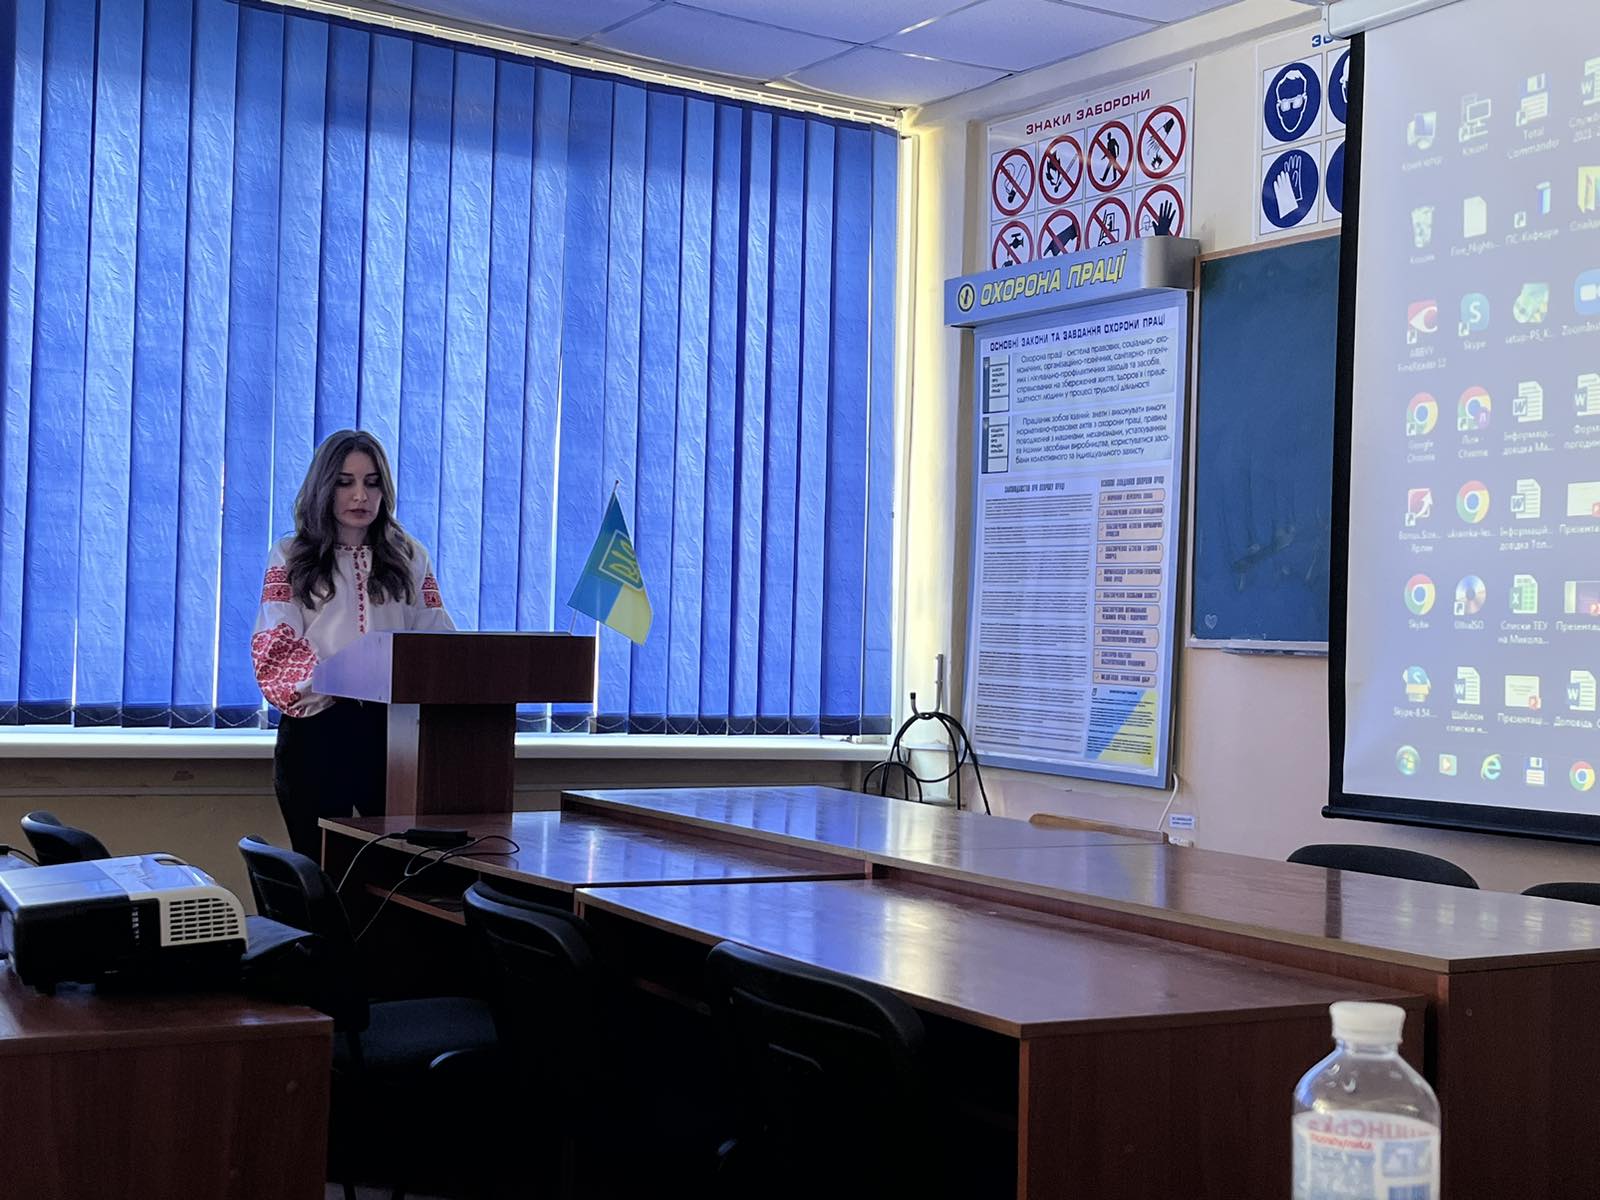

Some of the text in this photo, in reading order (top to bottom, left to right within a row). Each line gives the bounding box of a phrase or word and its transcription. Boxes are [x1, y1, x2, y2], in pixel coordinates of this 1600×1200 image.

[1026, 88, 1151, 135] ЗНАКИ ЗАБОРОНИ
[980, 248, 1128, 307] ОХОРОНА ПРАЦІ
[990, 313, 1166, 352] ОСНОВНІ ЗАКОНИ ТА ЗАВДАННЯ ОХОРОНИ ПРАЦІ
